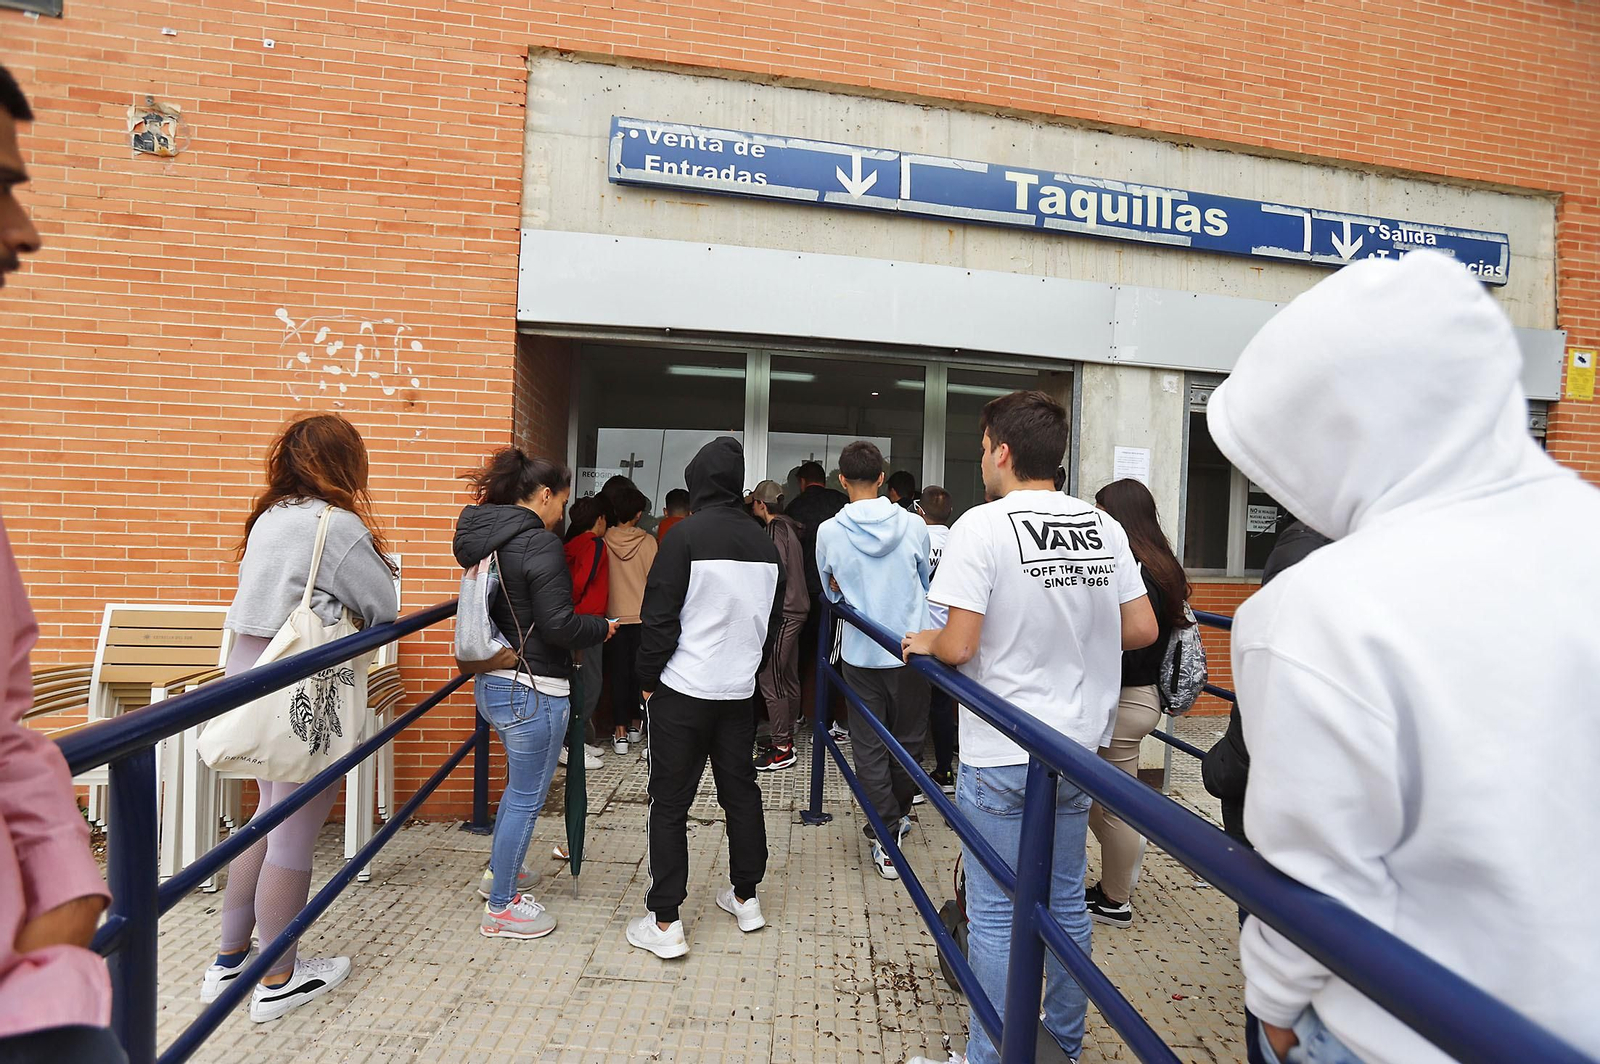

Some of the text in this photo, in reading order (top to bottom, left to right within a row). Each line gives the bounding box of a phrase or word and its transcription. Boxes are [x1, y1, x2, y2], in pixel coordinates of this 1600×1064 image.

[644, 126, 766, 158] Venta de
[644, 154, 768, 187] Entradas
[1004, 170, 1229, 237] Taquillas
[1378, 224, 1437, 246] Salida
[1021, 520, 1103, 551] VANS
[1023, 565, 1056, 577] "OFF
[1058, 564, 1084, 575] THE
[1044, 576, 1109, 589] SINCE 1966
[224, 755, 265, 765] PRIMARK
